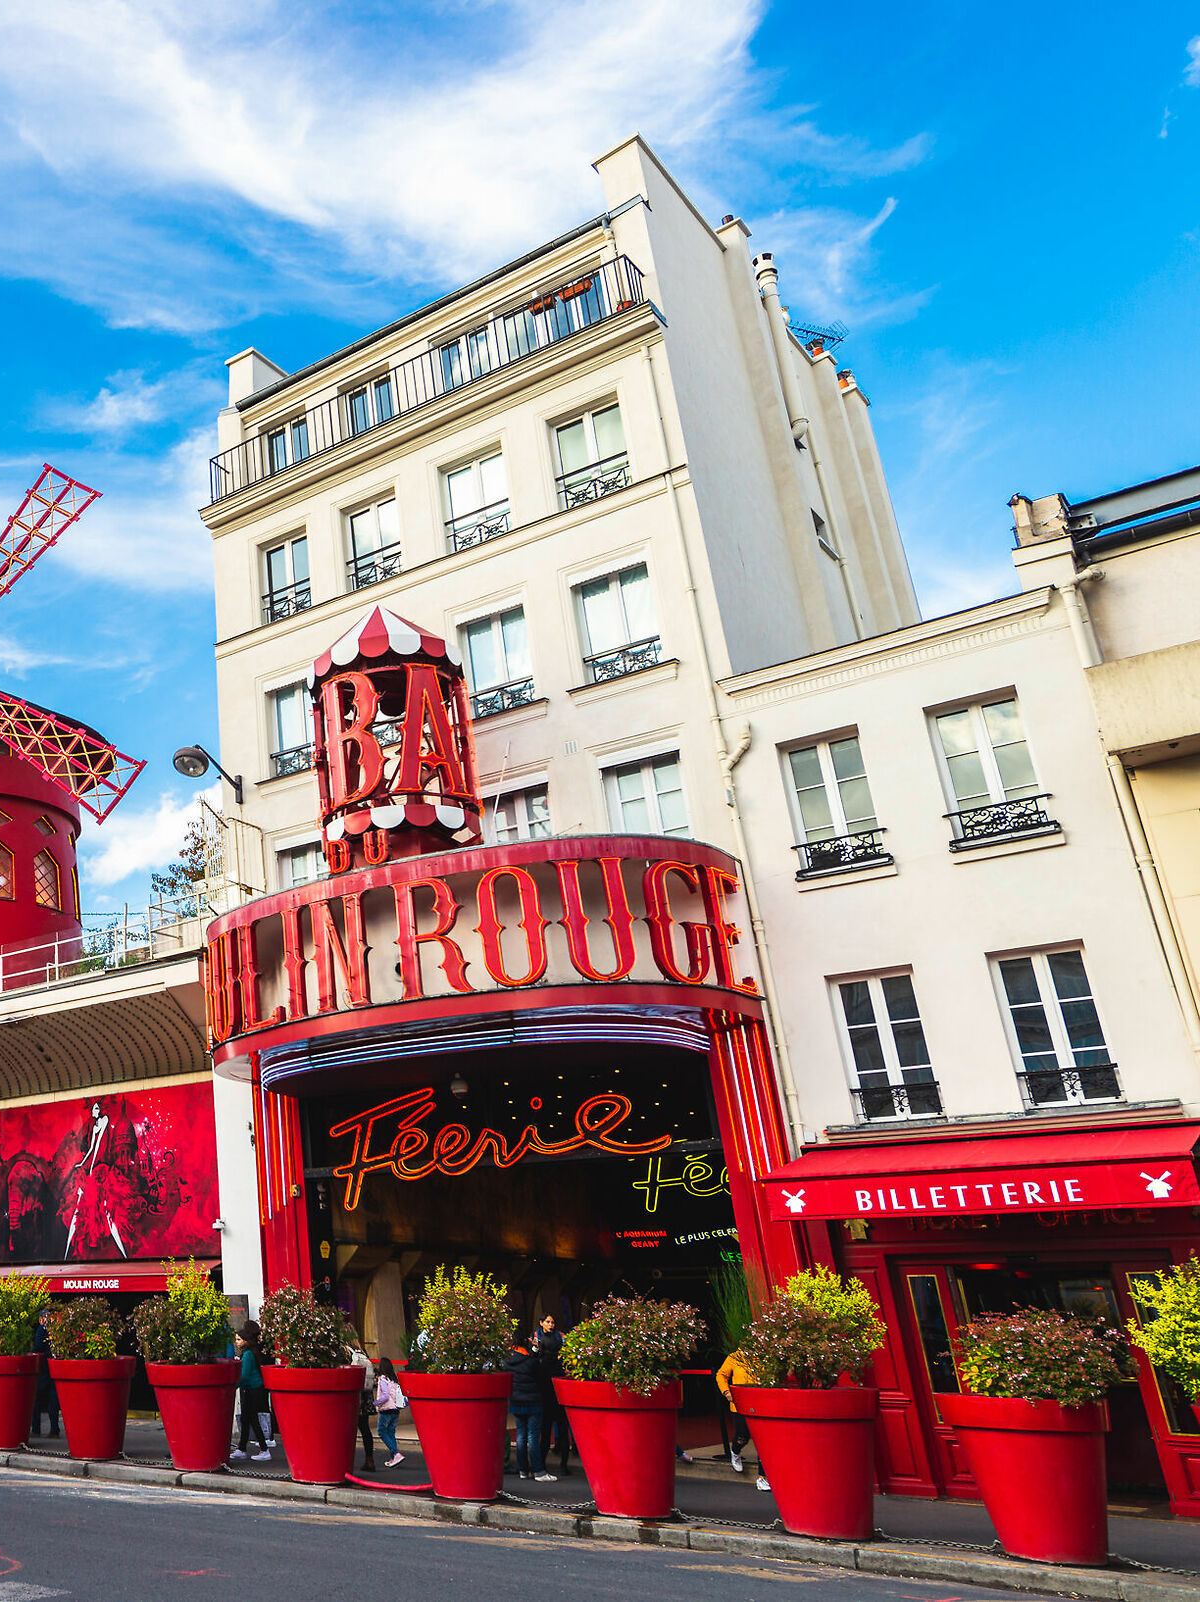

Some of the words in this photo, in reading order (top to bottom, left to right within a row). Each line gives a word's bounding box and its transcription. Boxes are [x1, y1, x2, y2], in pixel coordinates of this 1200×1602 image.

[326, 828, 389, 874] DU
[394, 857, 760, 1000] ROUGE
[329, 1087, 672, 1210] Féerie
[855, 1179, 1084, 1211] BILLETTERIE
[674, 1235, 687, 1245] LE
[688, 1231, 710, 1242] PLUS
[63, 1279, 92, 1289] MOULIN
[93, 1279, 120, 1289] ROUGE
